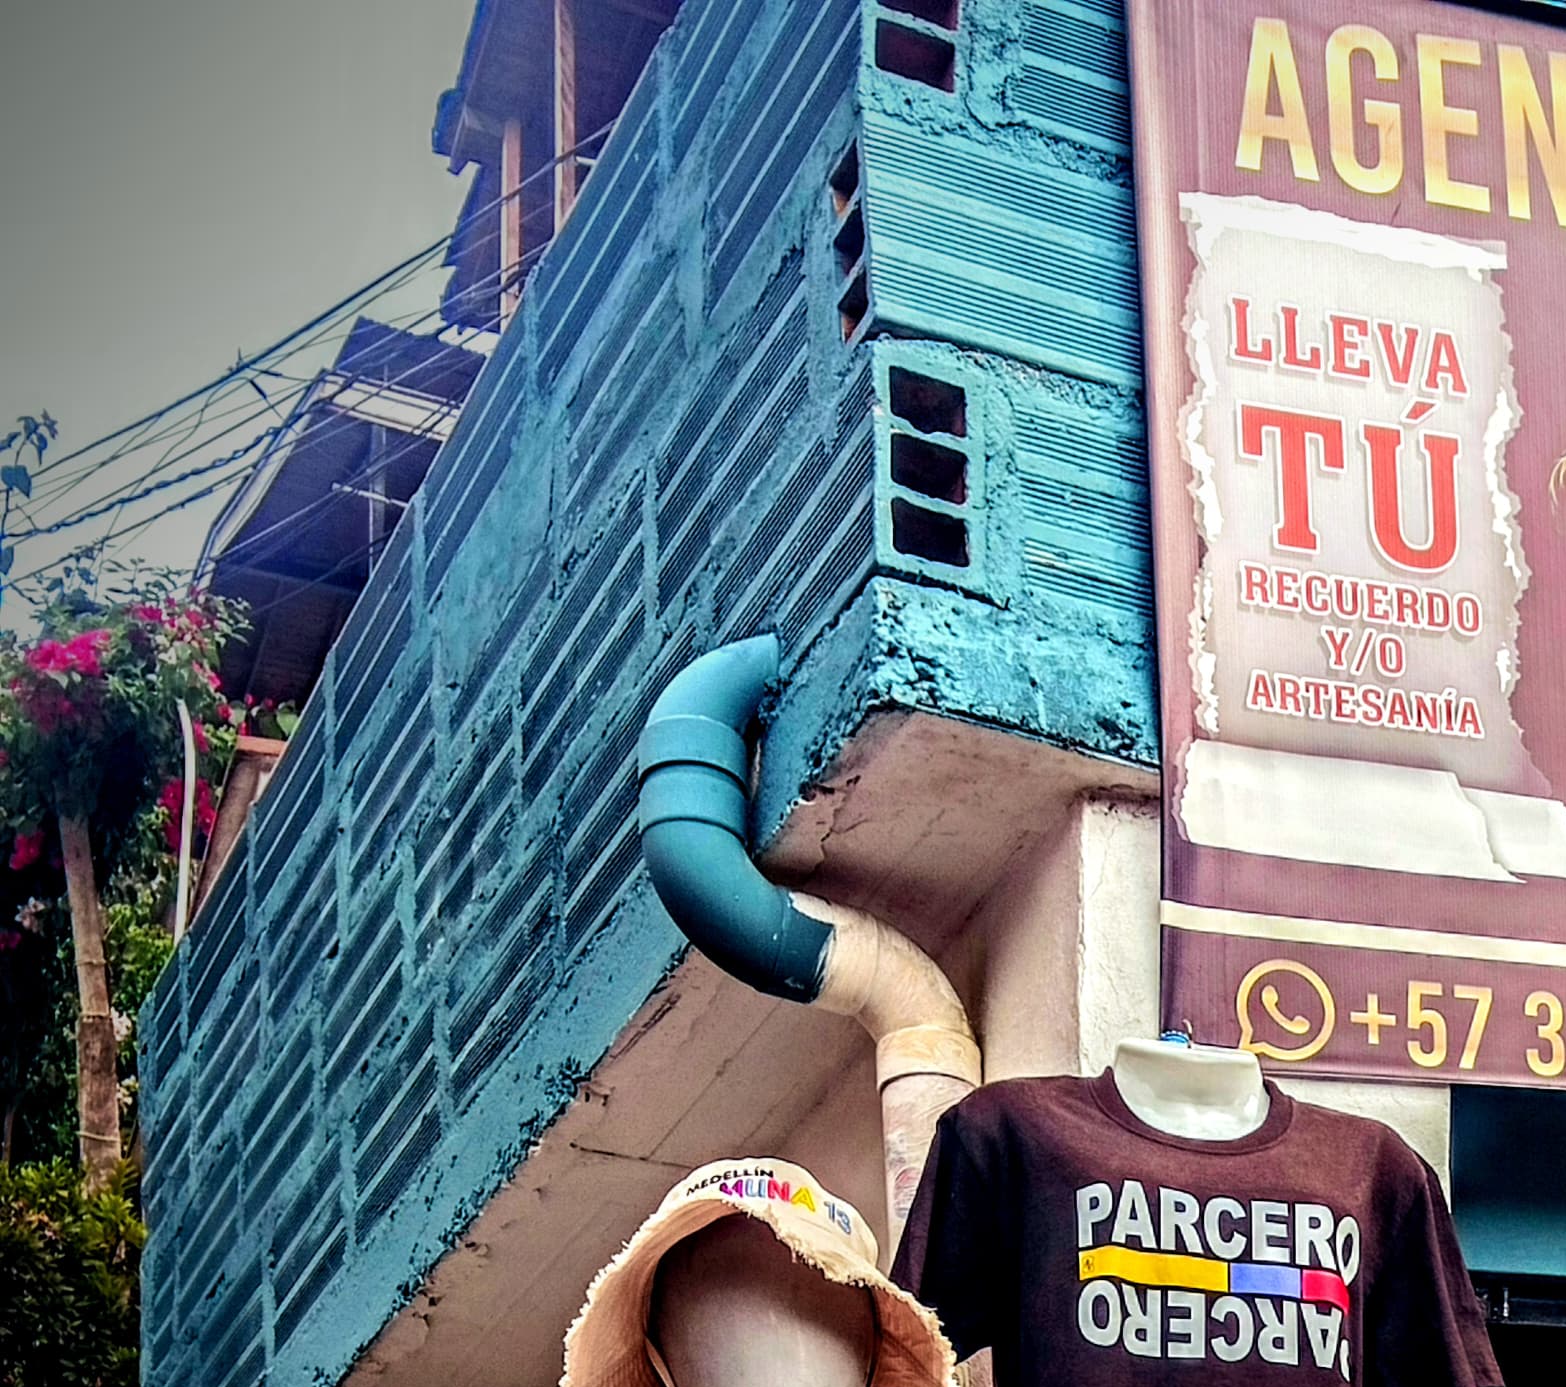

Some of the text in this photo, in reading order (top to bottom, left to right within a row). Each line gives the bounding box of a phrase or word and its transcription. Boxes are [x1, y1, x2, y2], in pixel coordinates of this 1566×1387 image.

[1231, 297, 1467, 395] LLEVA
[1239, 400, 1461, 571] TÚ
[1244, 565, 1482, 633] RECUERDO
[1325, 630, 1406, 675] Y/O
[1250, 672, 1484, 737] ARTESANÍA
[1350, 980, 1493, 1069] +57
[686, 1166, 774, 1196] MEDELLÍN
[1076, 1179, 1360, 1286] PARCERO
